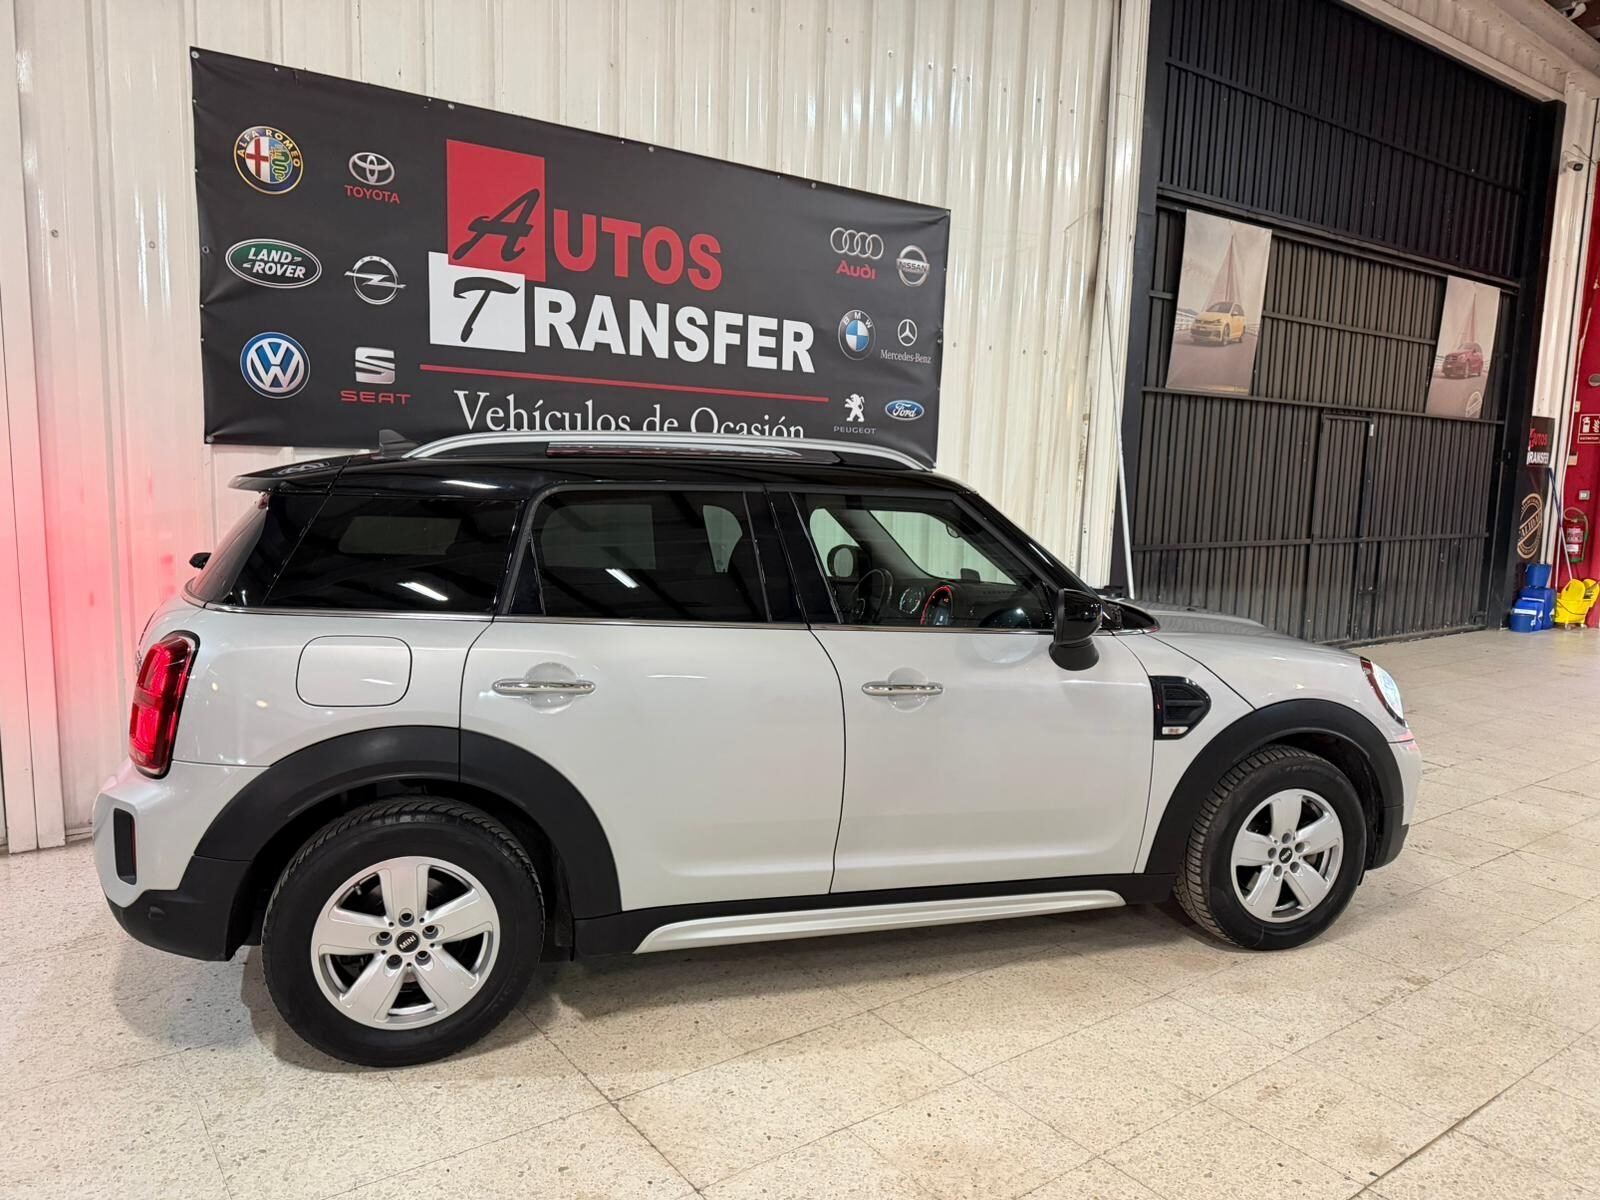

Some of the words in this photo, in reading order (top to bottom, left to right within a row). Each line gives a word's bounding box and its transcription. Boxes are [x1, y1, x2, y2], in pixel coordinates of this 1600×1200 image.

[237, 130, 260, 158] ALFA
[265, 129, 301, 167] ROMEO
[345, 185, 400, 204] TOYOTA
[247, 247, 293, 264] LAND
[252, 261, 306, 279] ROVER
[836, 261, 876, 279] Audi
[842, 311, 873, 329] BMW
[880, 349, 932, 364] Mercedes-Benz
[340, 390, 412, 405] SEAT
[453, 390, 632, 431] Vehículos
[642, 404, 679, 432] de
[690, 407, 804, 439] Ocasión
[892, 403, 917, 418] Ford
[833, 426, 877, 434] PEUGEOT
[398, 935, 416, 949] MINI
